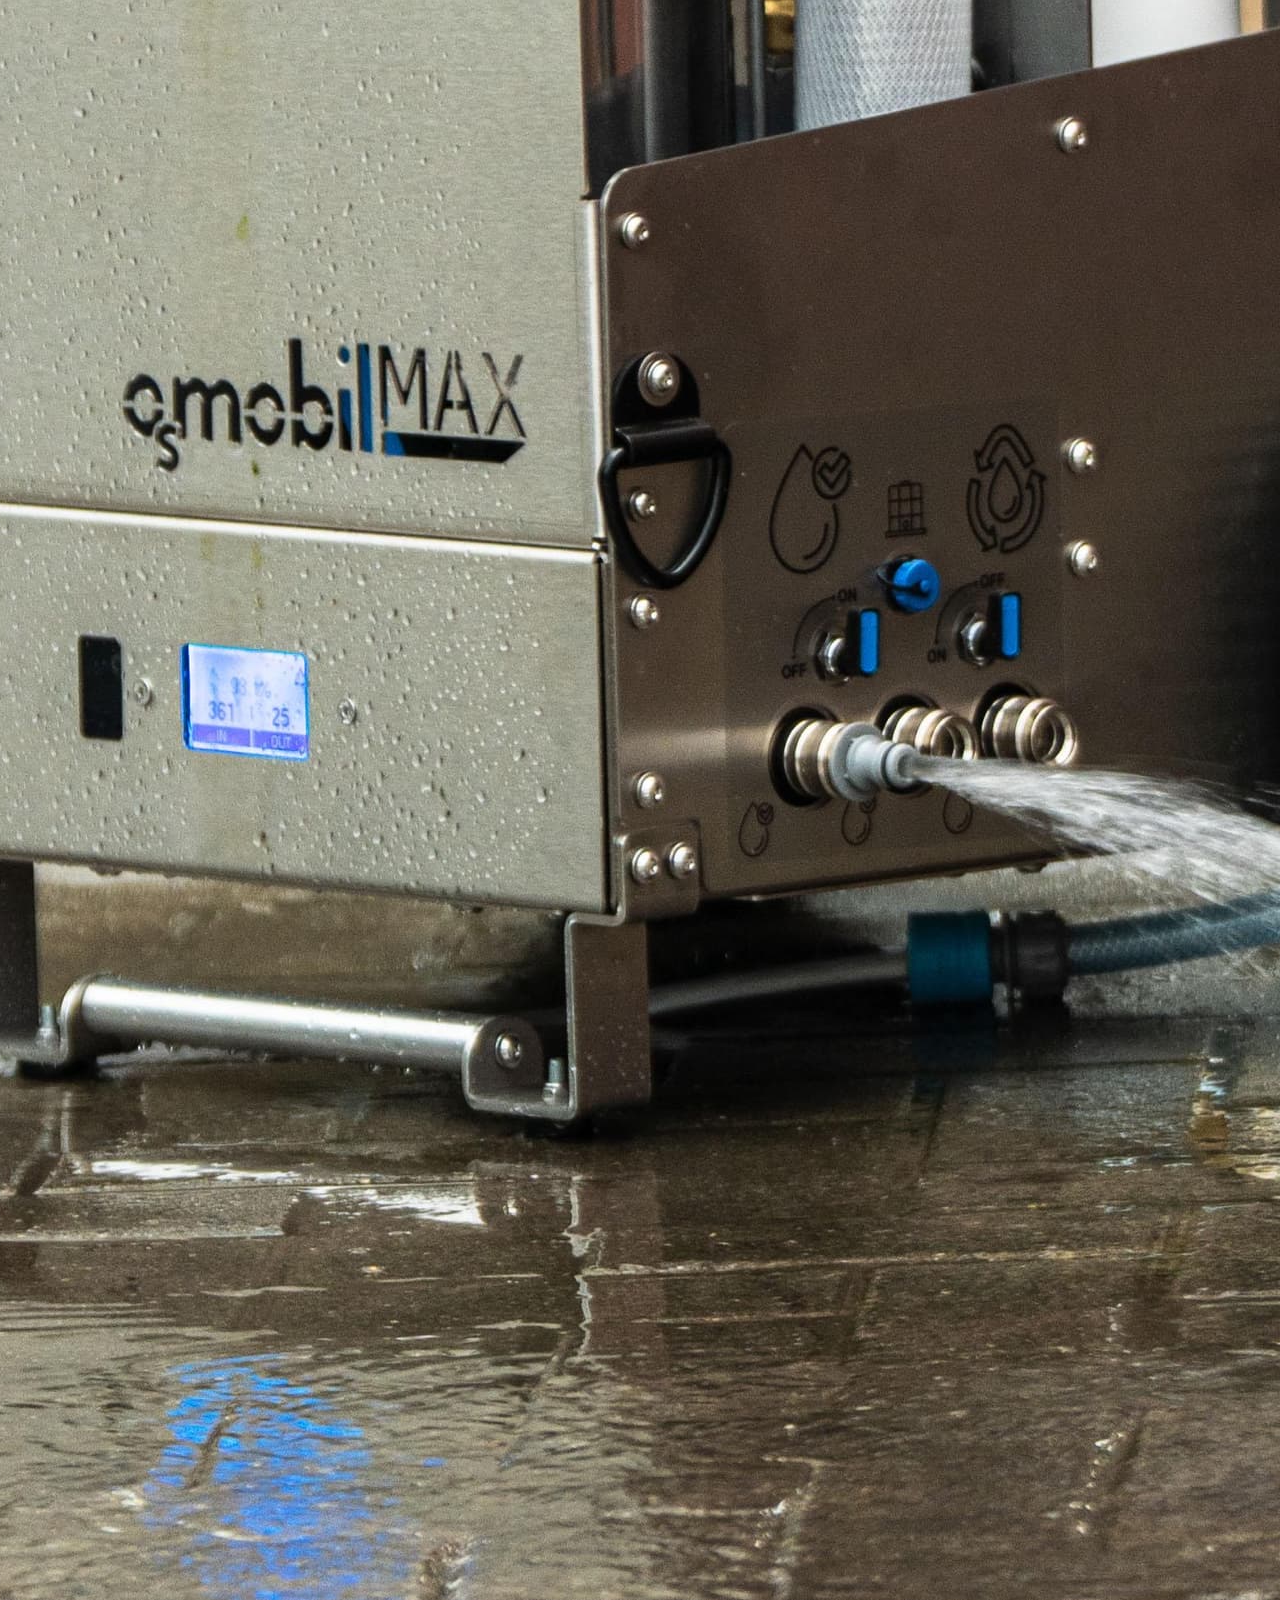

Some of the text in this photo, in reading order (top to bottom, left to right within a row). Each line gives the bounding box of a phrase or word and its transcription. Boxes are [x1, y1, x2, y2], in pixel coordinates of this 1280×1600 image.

[981, 572, 1005, 587] OFF
[837, 588, 857, 602] ON
[927, 649, 946, 664] ON
[781, 662, 807, 679] OFF
[272, 707, 290, 727] 25
